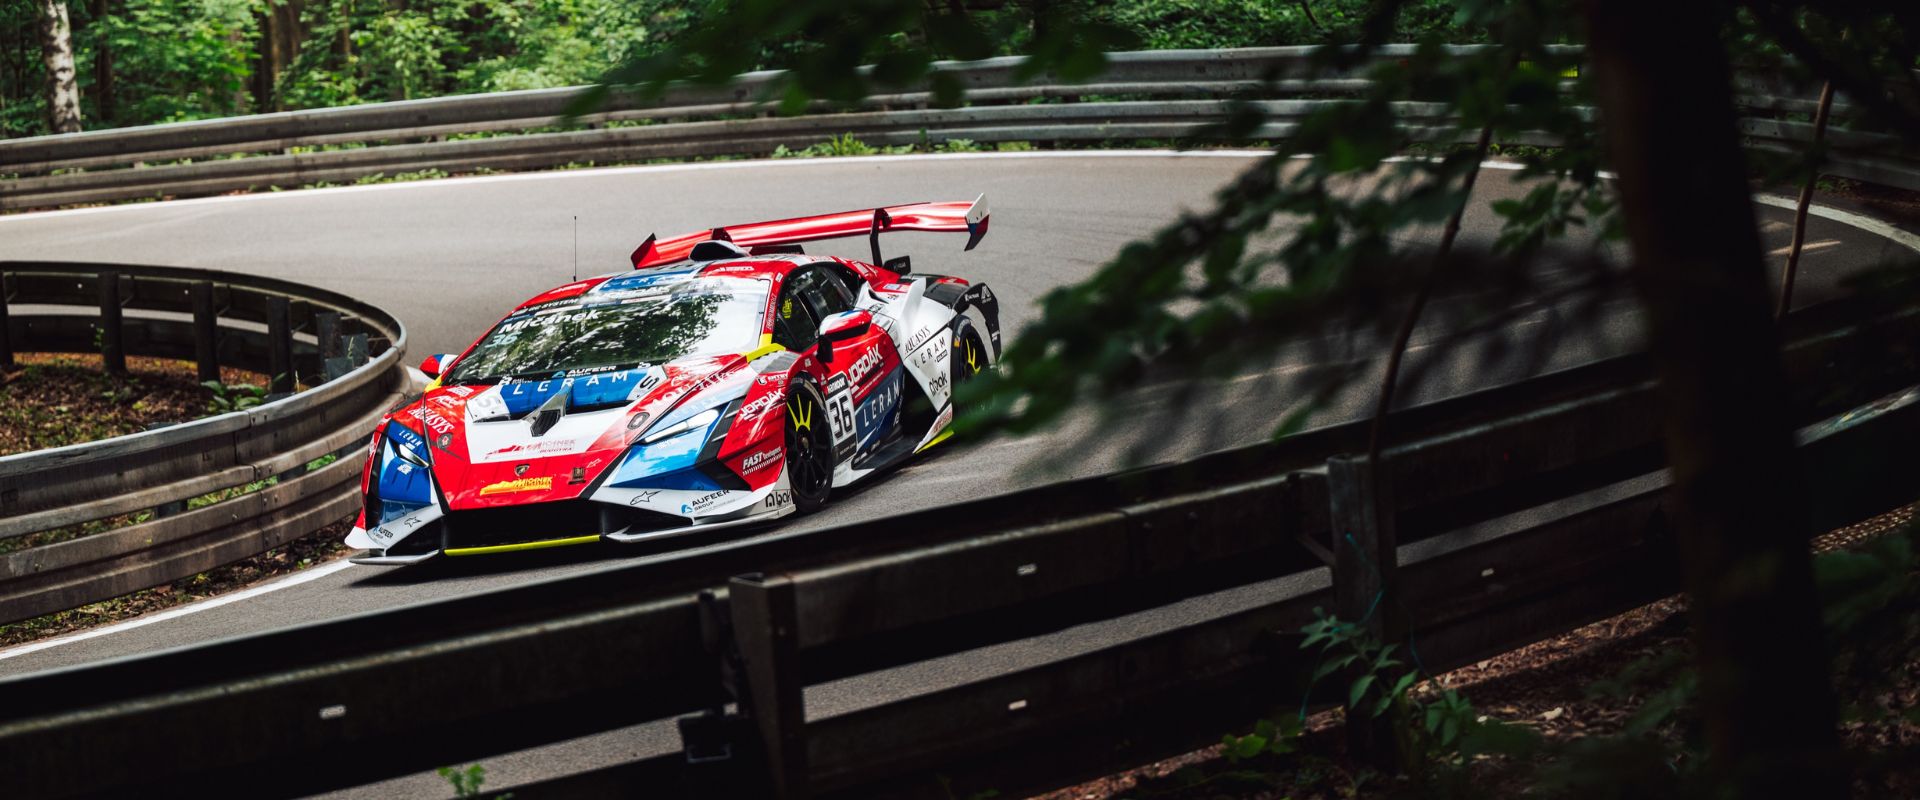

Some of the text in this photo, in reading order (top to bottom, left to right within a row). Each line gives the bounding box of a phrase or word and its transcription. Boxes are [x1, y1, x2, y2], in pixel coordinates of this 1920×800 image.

[487, 332, 523, 348] 36
[914, 337, 946, 368] LERAM
[567, 366, 616, 375] AUFEER
[848, 344, 883, 387] JORDÁK
[513, 370, 629, 394] LERAM
[863, 379, 900, 427] LERAM
[829, 395, 853, 439] 36
[743, 451, 763, 470] FAST
[692, 489, 730, 506] AUFEER
